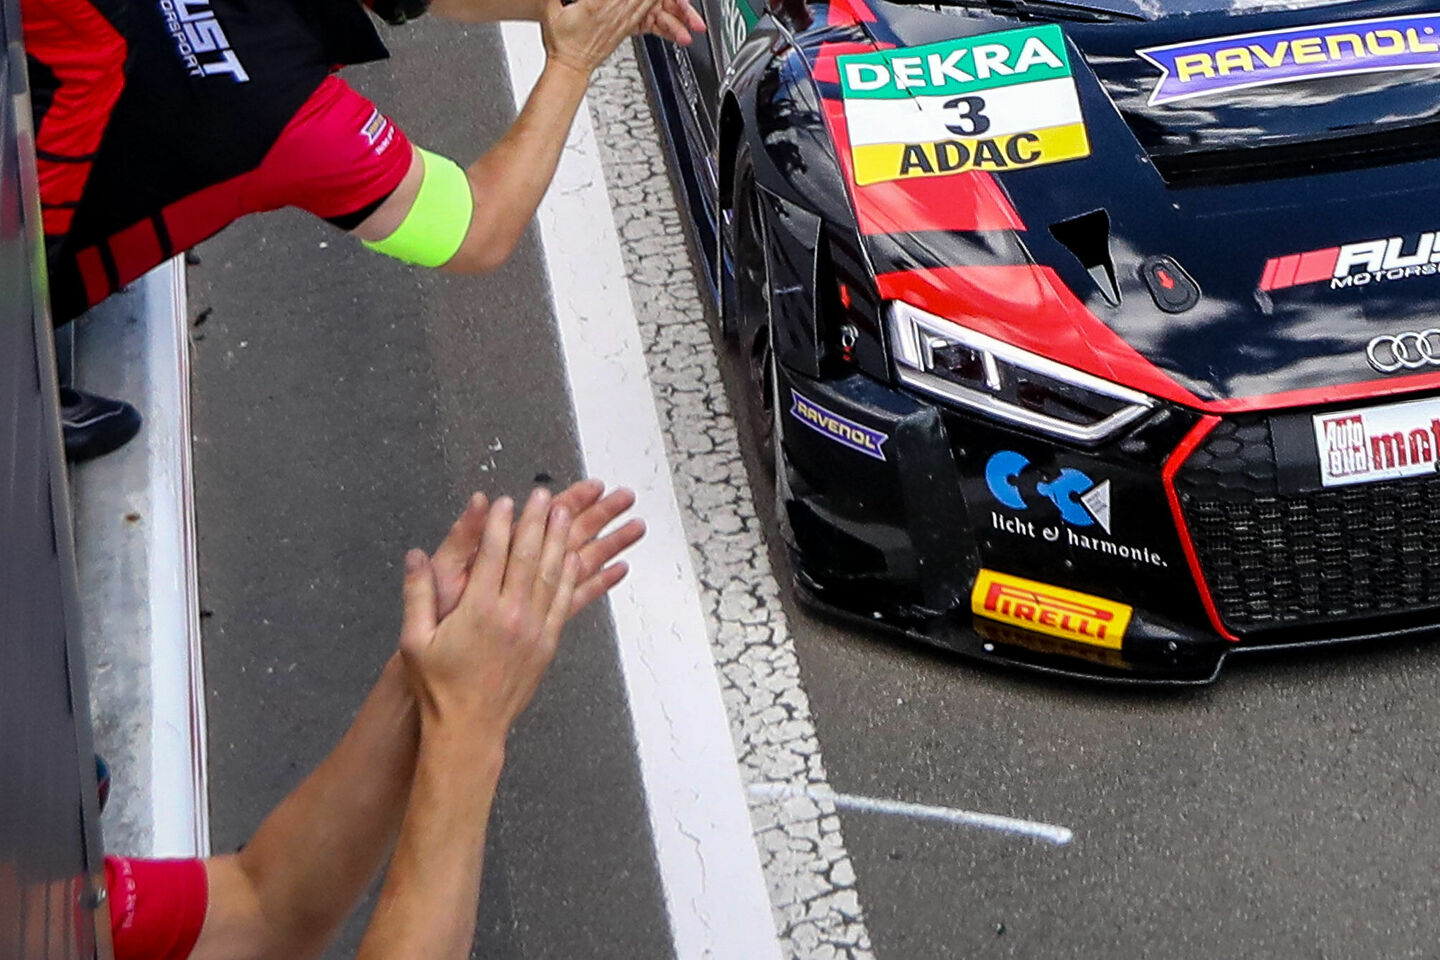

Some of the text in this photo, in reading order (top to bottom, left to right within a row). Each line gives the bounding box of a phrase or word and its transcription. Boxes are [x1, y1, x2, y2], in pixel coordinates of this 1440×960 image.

[844, 37, 1065, 91] DEKRA
[1173, 27, 1440, 83] RAVENOL
[942, 95, 991, 136] 3
[899, 132, 1042, 177] ADAC
[797, 400, 876, 450] RAVENOL
[991, 511, 1036, 538] licht
[984, 581, 1115, 640] PIRELLI
